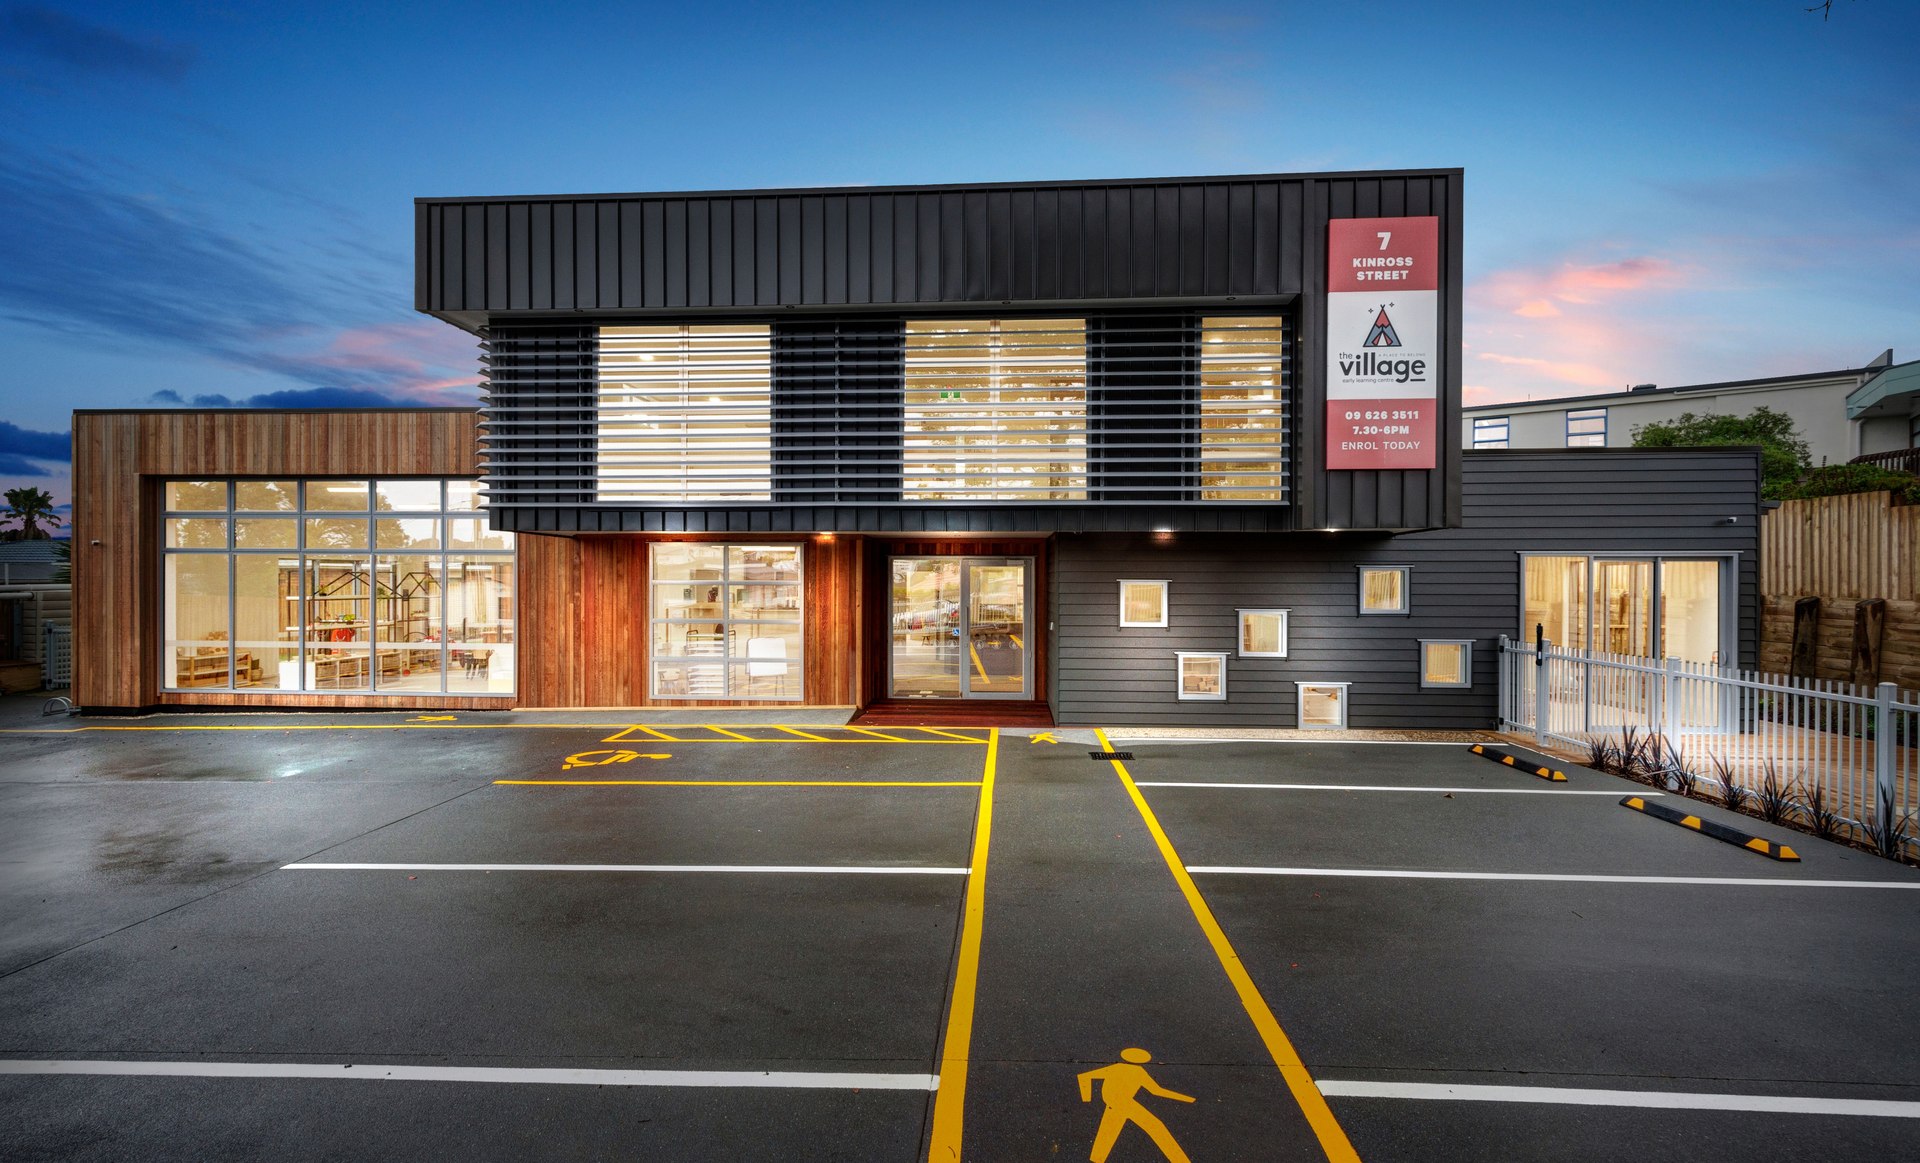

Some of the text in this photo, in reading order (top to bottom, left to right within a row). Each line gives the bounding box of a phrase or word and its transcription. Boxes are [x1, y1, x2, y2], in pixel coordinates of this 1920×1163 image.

[1377, 232, 1391, 250] 7
[1352, 257, 1413, 268] KINROSS
[1357, 270, 1409, 280] STREET
[1339, 352, 1353, 360] the
[1339, 352, 1426, 383] village
[1345, 410, 1419, 420] 09 626 3511
[1352, 425, 1409, 434] 7.30-6PM
[1342, 441, 1420, 450] ENROL TODAY
